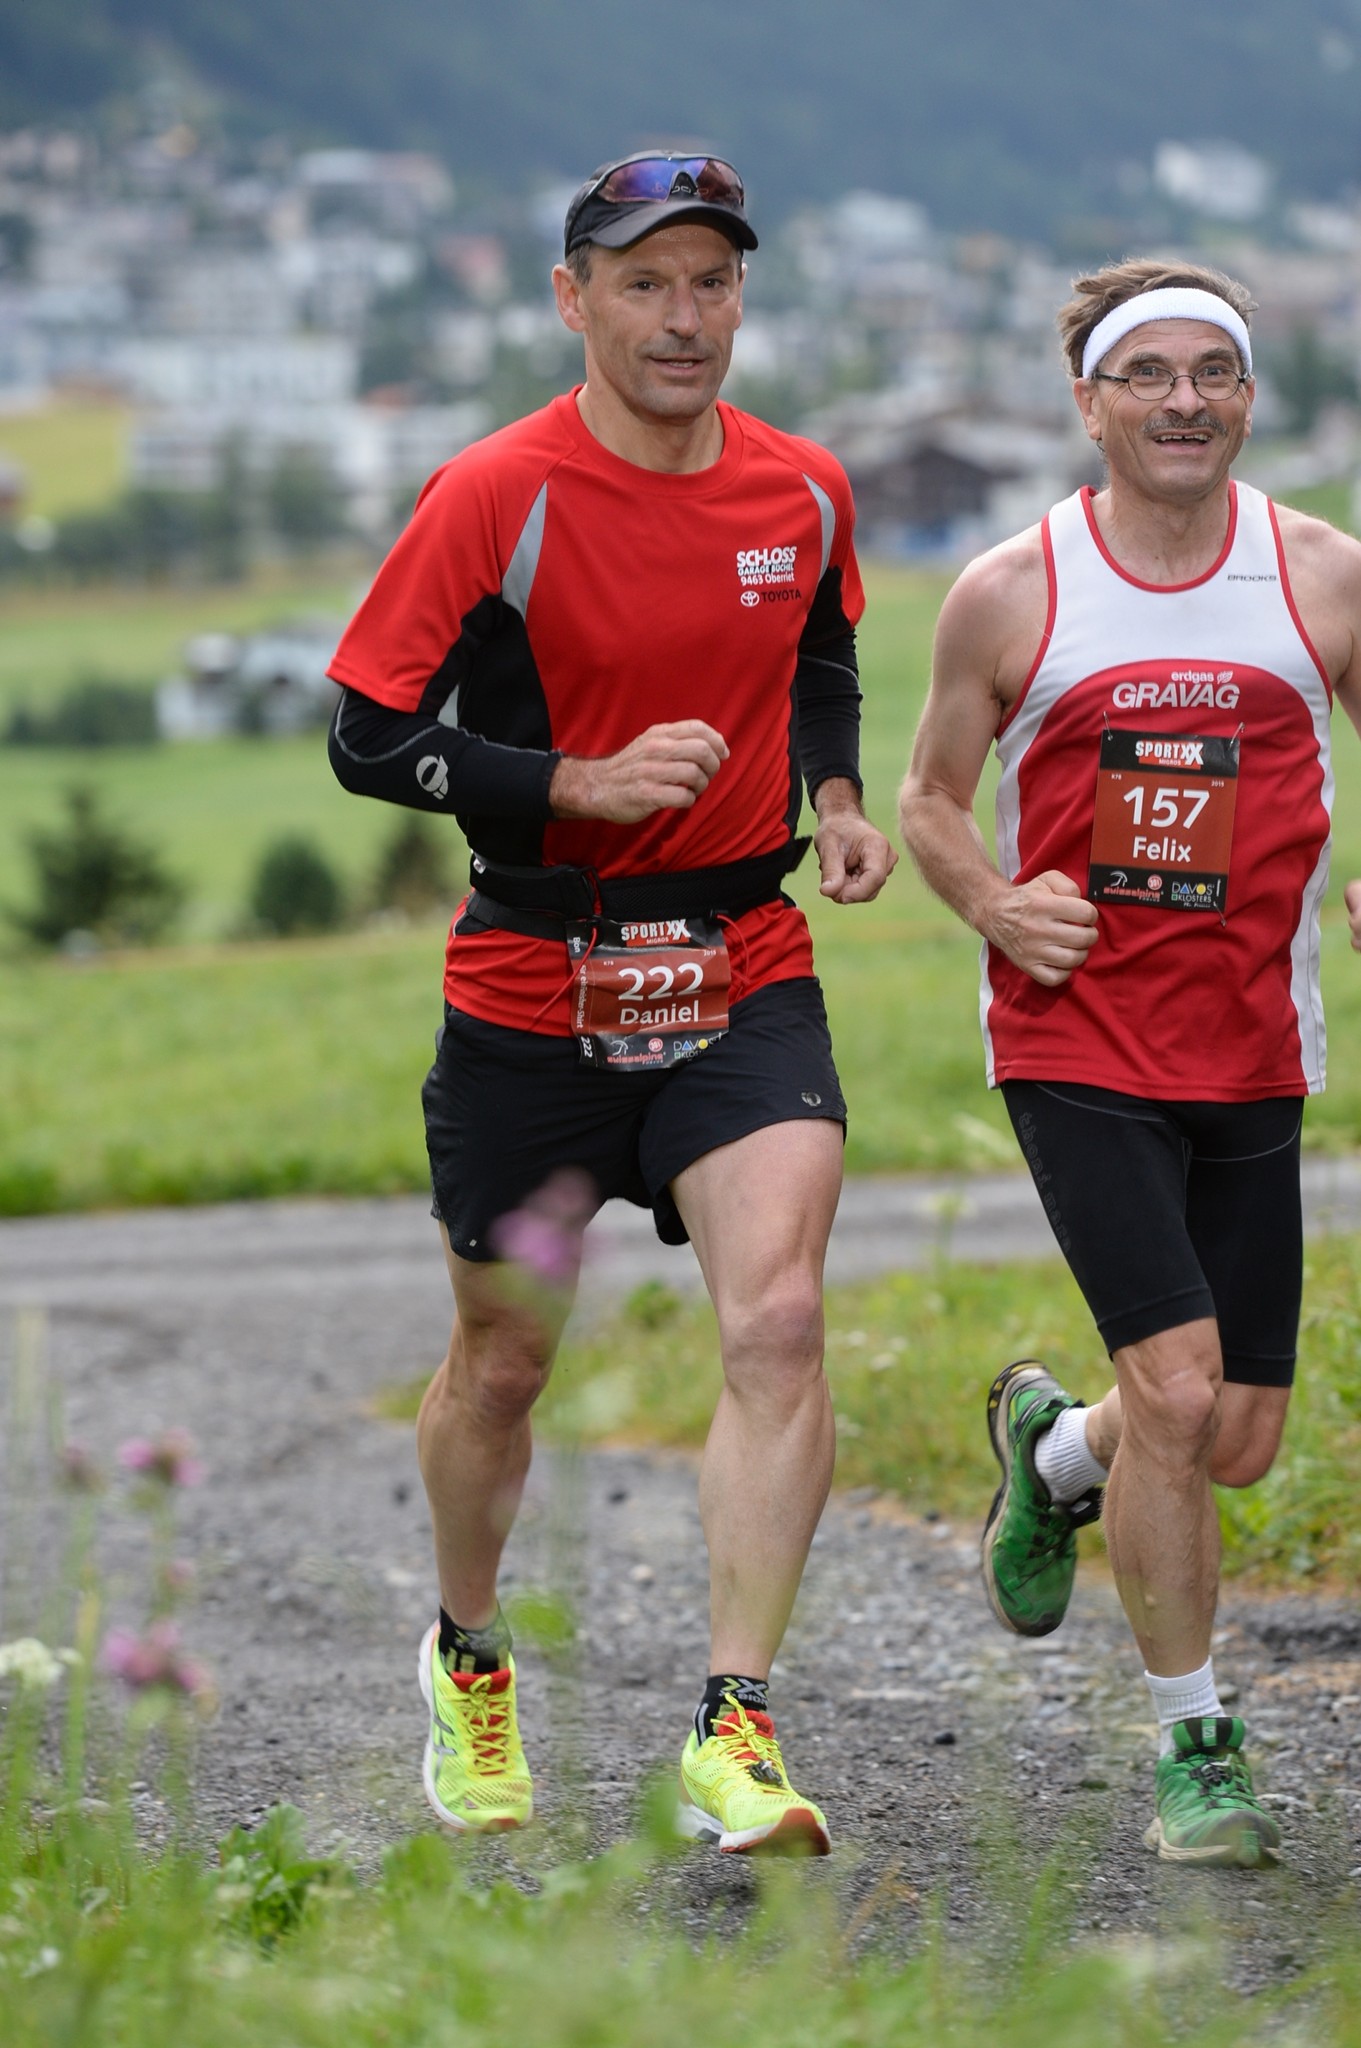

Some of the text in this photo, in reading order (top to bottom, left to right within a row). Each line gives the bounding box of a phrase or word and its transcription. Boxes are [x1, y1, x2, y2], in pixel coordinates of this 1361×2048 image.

[736, 546, 797, 567] SCHLOSS
[738, 566, 770, 576] GARAGE
[740, 575, 764, 586] 9463
[1227, 574, 1277, 582] BROOKS
[761, 589, 802, 602] TOYOTA
[1171, 670, 1214, 683] erdgas
[1112, 682, 1240, 709] GRAVAG
[1135, 740, 1204, 766] SPORTXX
[1158, 758, 1181, 766] MIGROS
[1123, 785, 1210, 829] 157
[1132, 836, 1192, 863] Felix
[1179, 893, 1212, 903] KLOSTERS
[620, 919, 691, 941] SPORTXX
[572, 937, 581, 953] Bon
[618, 962, 704, 1001] 222
[620, 1000, 699, 1025] Daniel
[580, 1036, 593, 1058] 222
